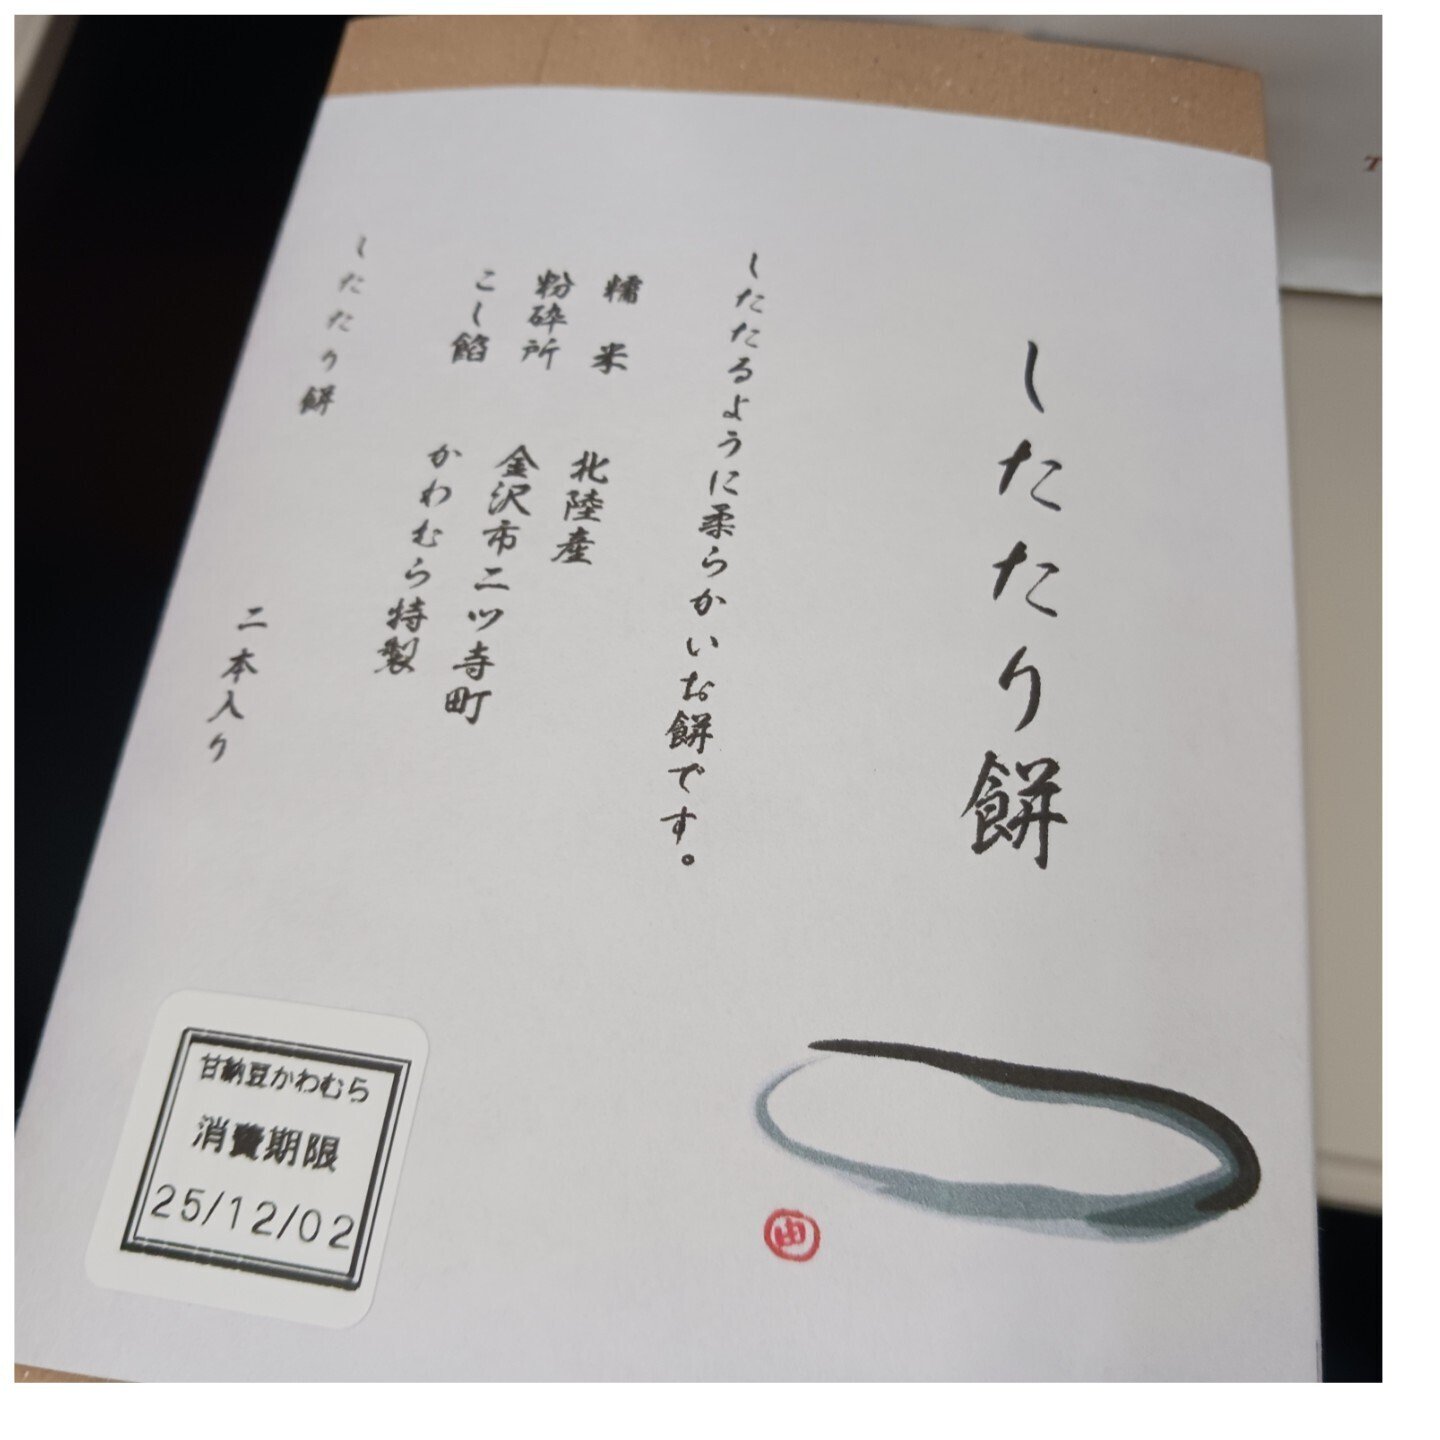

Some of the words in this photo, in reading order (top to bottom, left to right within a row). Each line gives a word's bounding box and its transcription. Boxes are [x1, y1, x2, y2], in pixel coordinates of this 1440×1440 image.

[298, 235, 367, 417] したたり餅
[520, 269, 576, 371] 粉砕所
[373, 443, 463, 675] かわむら特製
[549, 449, 611, 565] 北陸産
[660, 251, 766, 868] したたるように柔らかいお餅です。
[960, 339, 1068, 871] したたり餅
[206, 605, 269, 763] 二本入り
[191, 1113, 341, 1174] 消費期限
[199, 1052, 370, 1104] 甘納豆かわむら
[150, 1184, 355, 1250] 25/12/02
